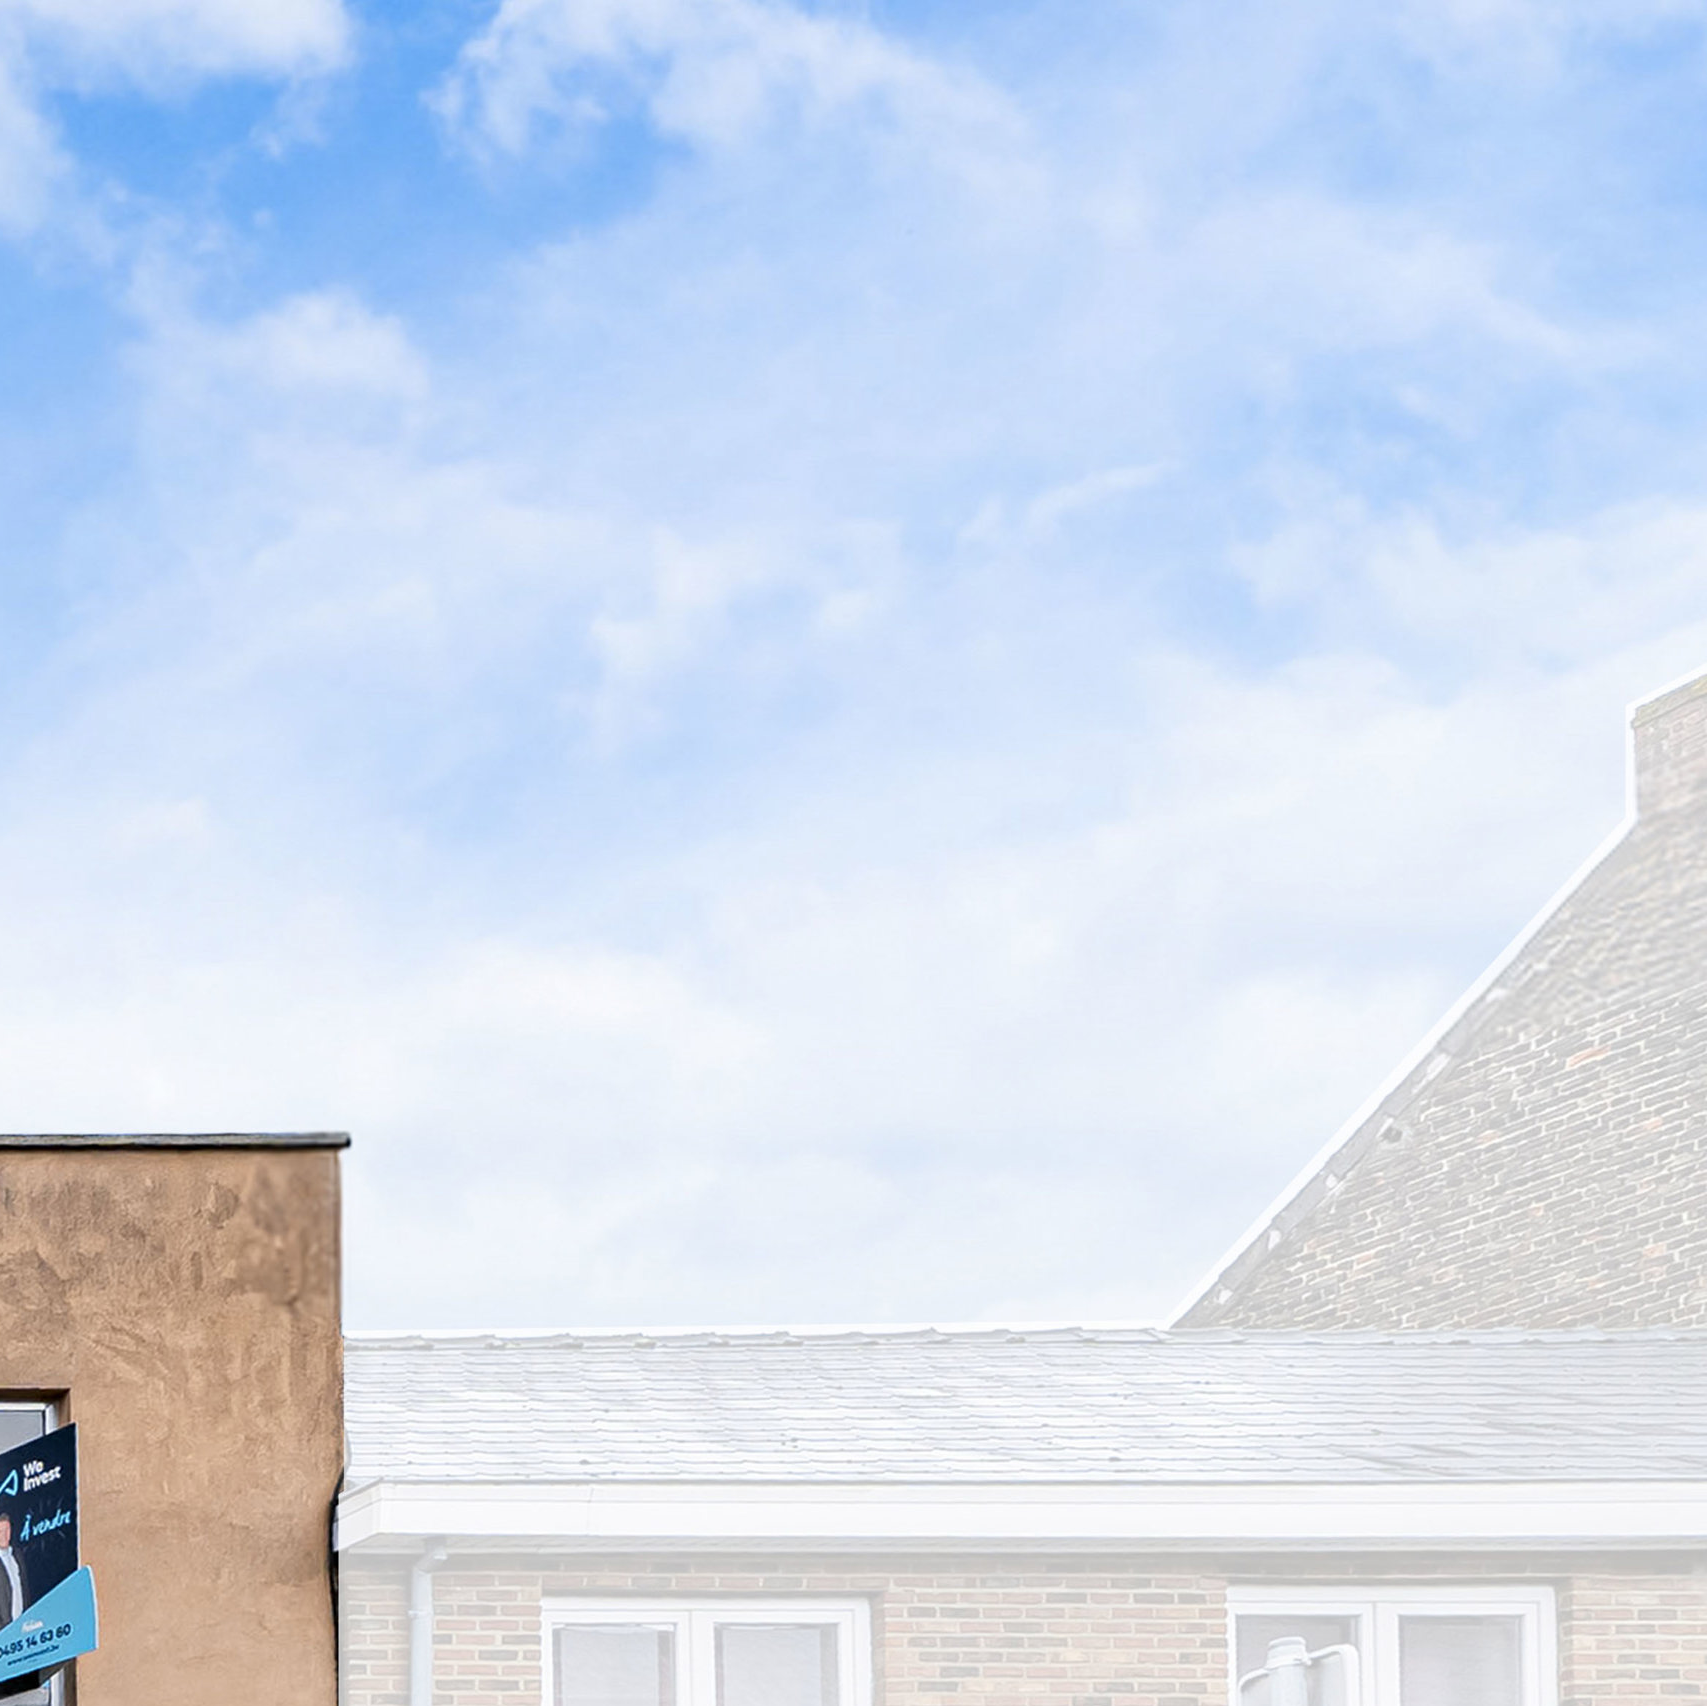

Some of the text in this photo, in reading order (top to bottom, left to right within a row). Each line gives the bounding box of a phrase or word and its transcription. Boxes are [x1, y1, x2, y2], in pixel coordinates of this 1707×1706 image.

[23, 1461, 44, 1477] We
[23, 1466, 61, 1492] Invest
[25, 1635, 38, 1649] 14
